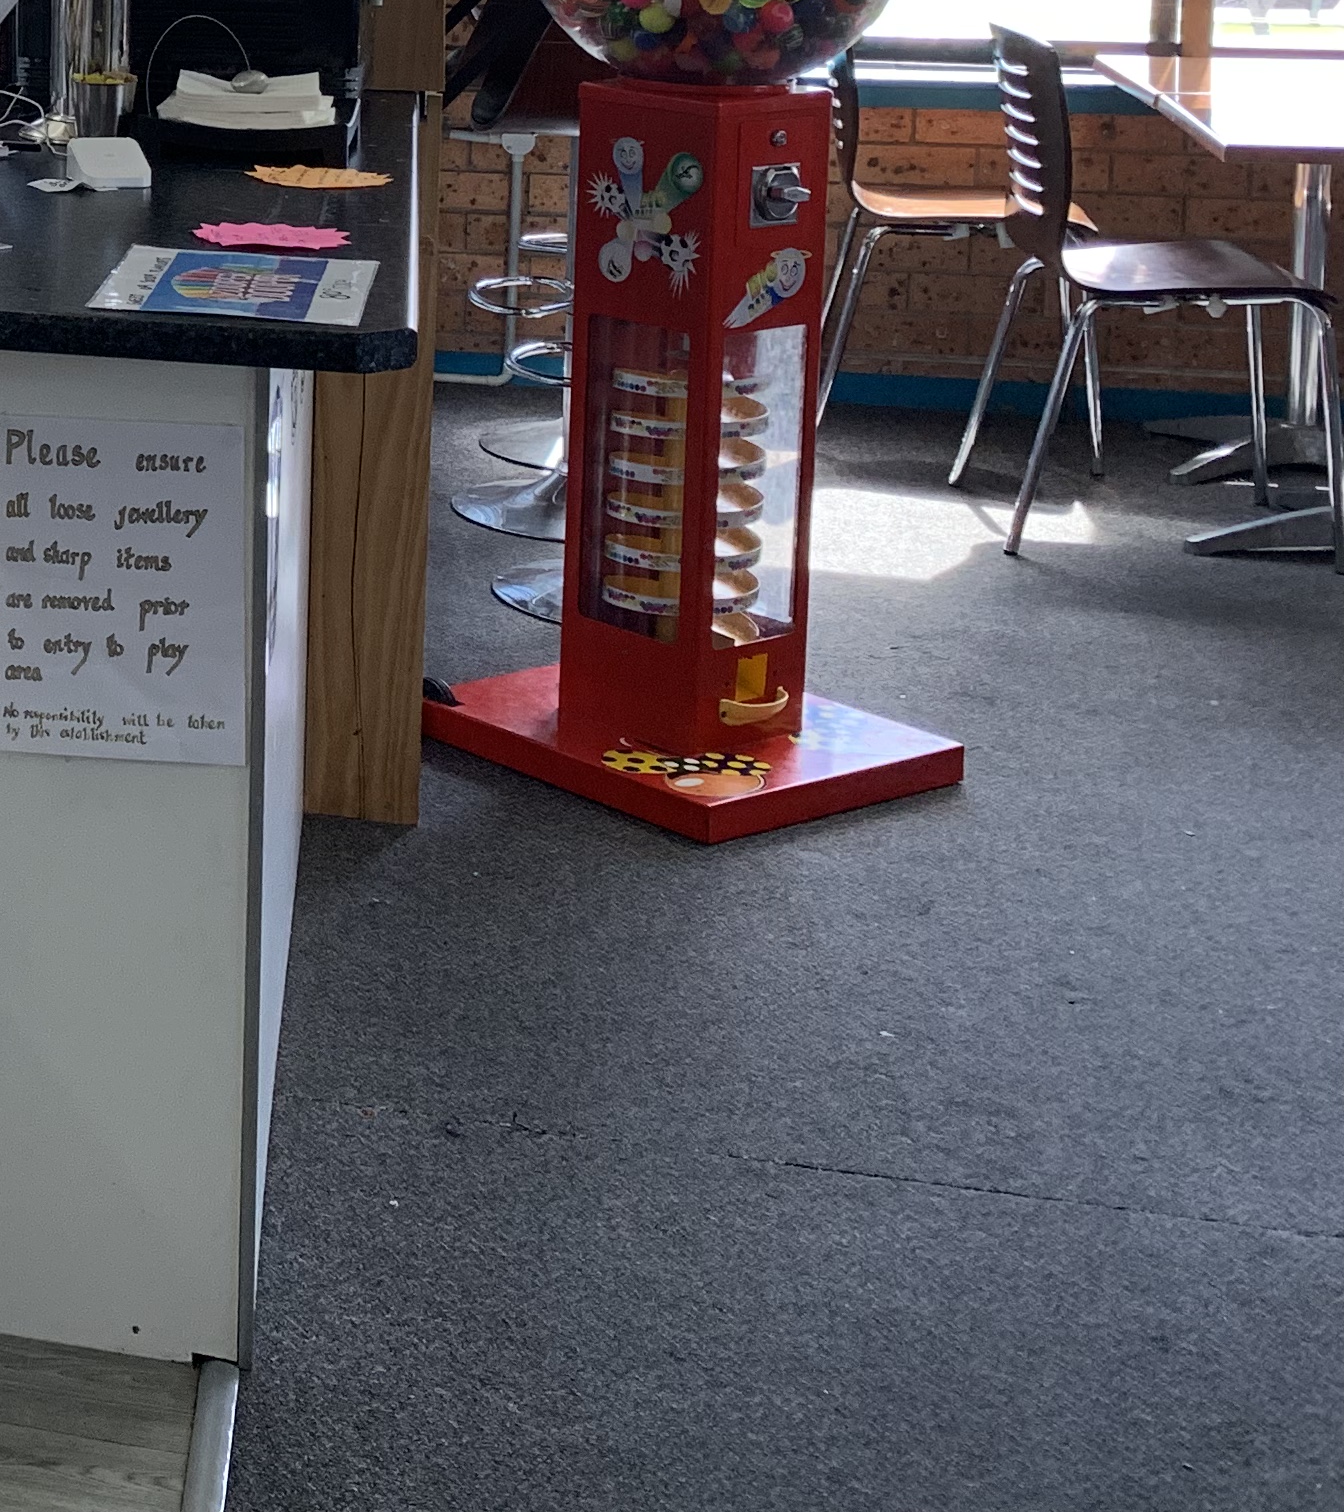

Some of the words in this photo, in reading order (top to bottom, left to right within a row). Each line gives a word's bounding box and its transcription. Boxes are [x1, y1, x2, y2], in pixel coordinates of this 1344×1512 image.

[5, 428, 101, 469] Please
[135, 452, 208, 474] ensure
[5, 492, 30, 519] all
[48, 493, 97, 522] loose
[113, 500, 209, 539] jewellery
[5, 539, 37, 564] and
[43, 539, 93, 582] sharp
[115, 546, 173, 573] items
[5, 591, 34, 610] are
[41, 588, 116, 613] removed
[138, 595, 190, 632] prior
[4, 663, 43, 682] area
[7, 627, 25, 651] to
[43, 632, 92, 676] entry
[105, 632, 125, 658] to
[145, 636, 190, 677] play
[2, 701, 20, 719] No
[122, 712, 149, 728] will
